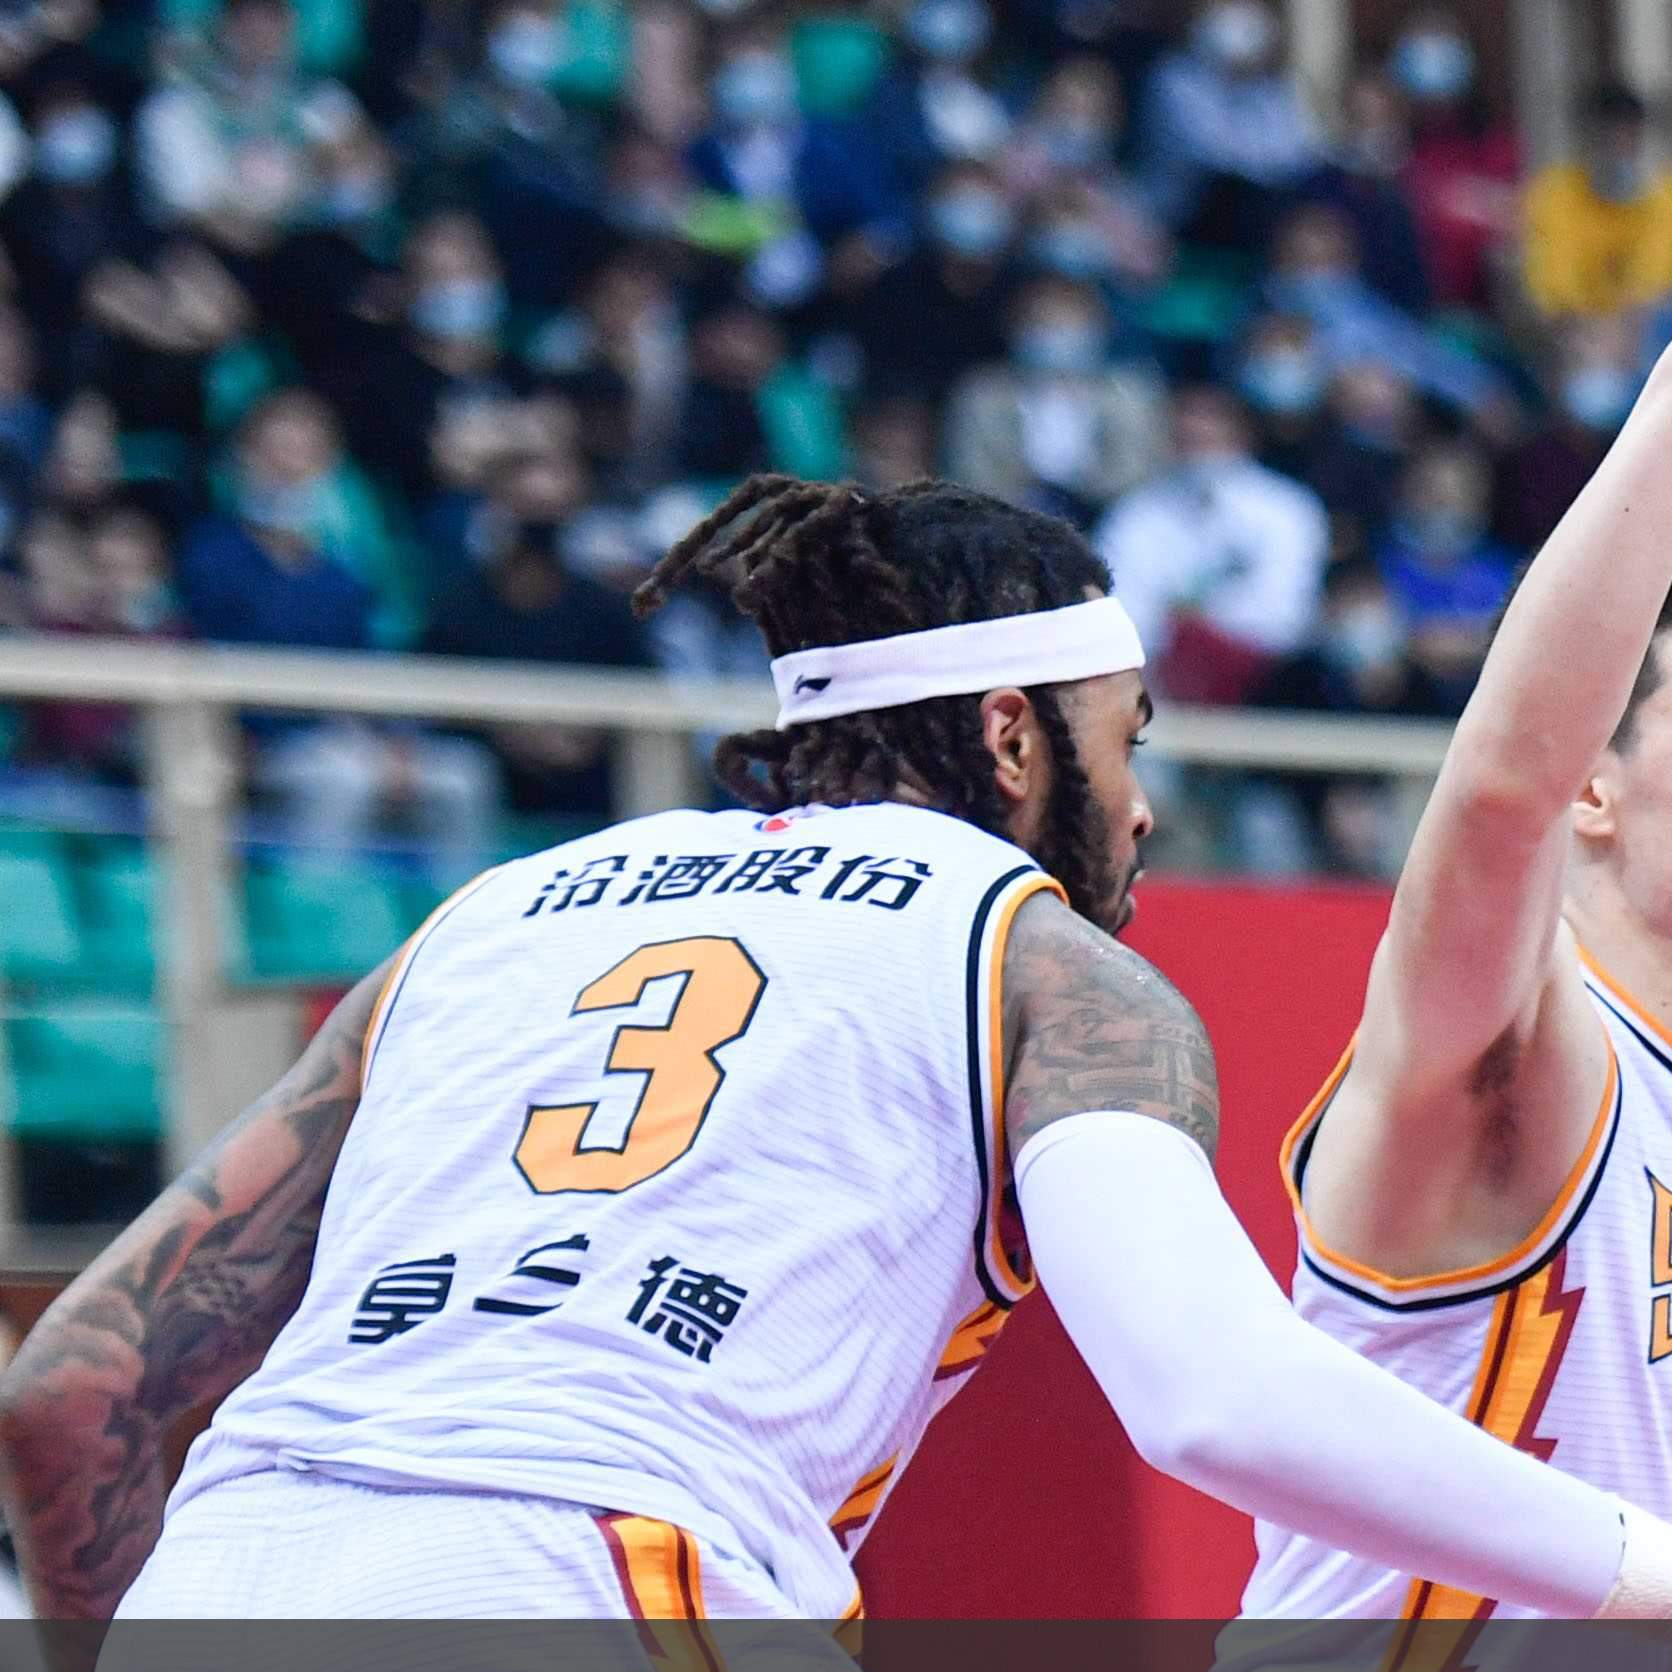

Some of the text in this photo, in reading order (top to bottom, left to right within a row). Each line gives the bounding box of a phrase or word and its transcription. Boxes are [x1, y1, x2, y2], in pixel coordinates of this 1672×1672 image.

[521, 846, 934, 918] 汾酒股份
[511, 934, 769, 1195] 3
